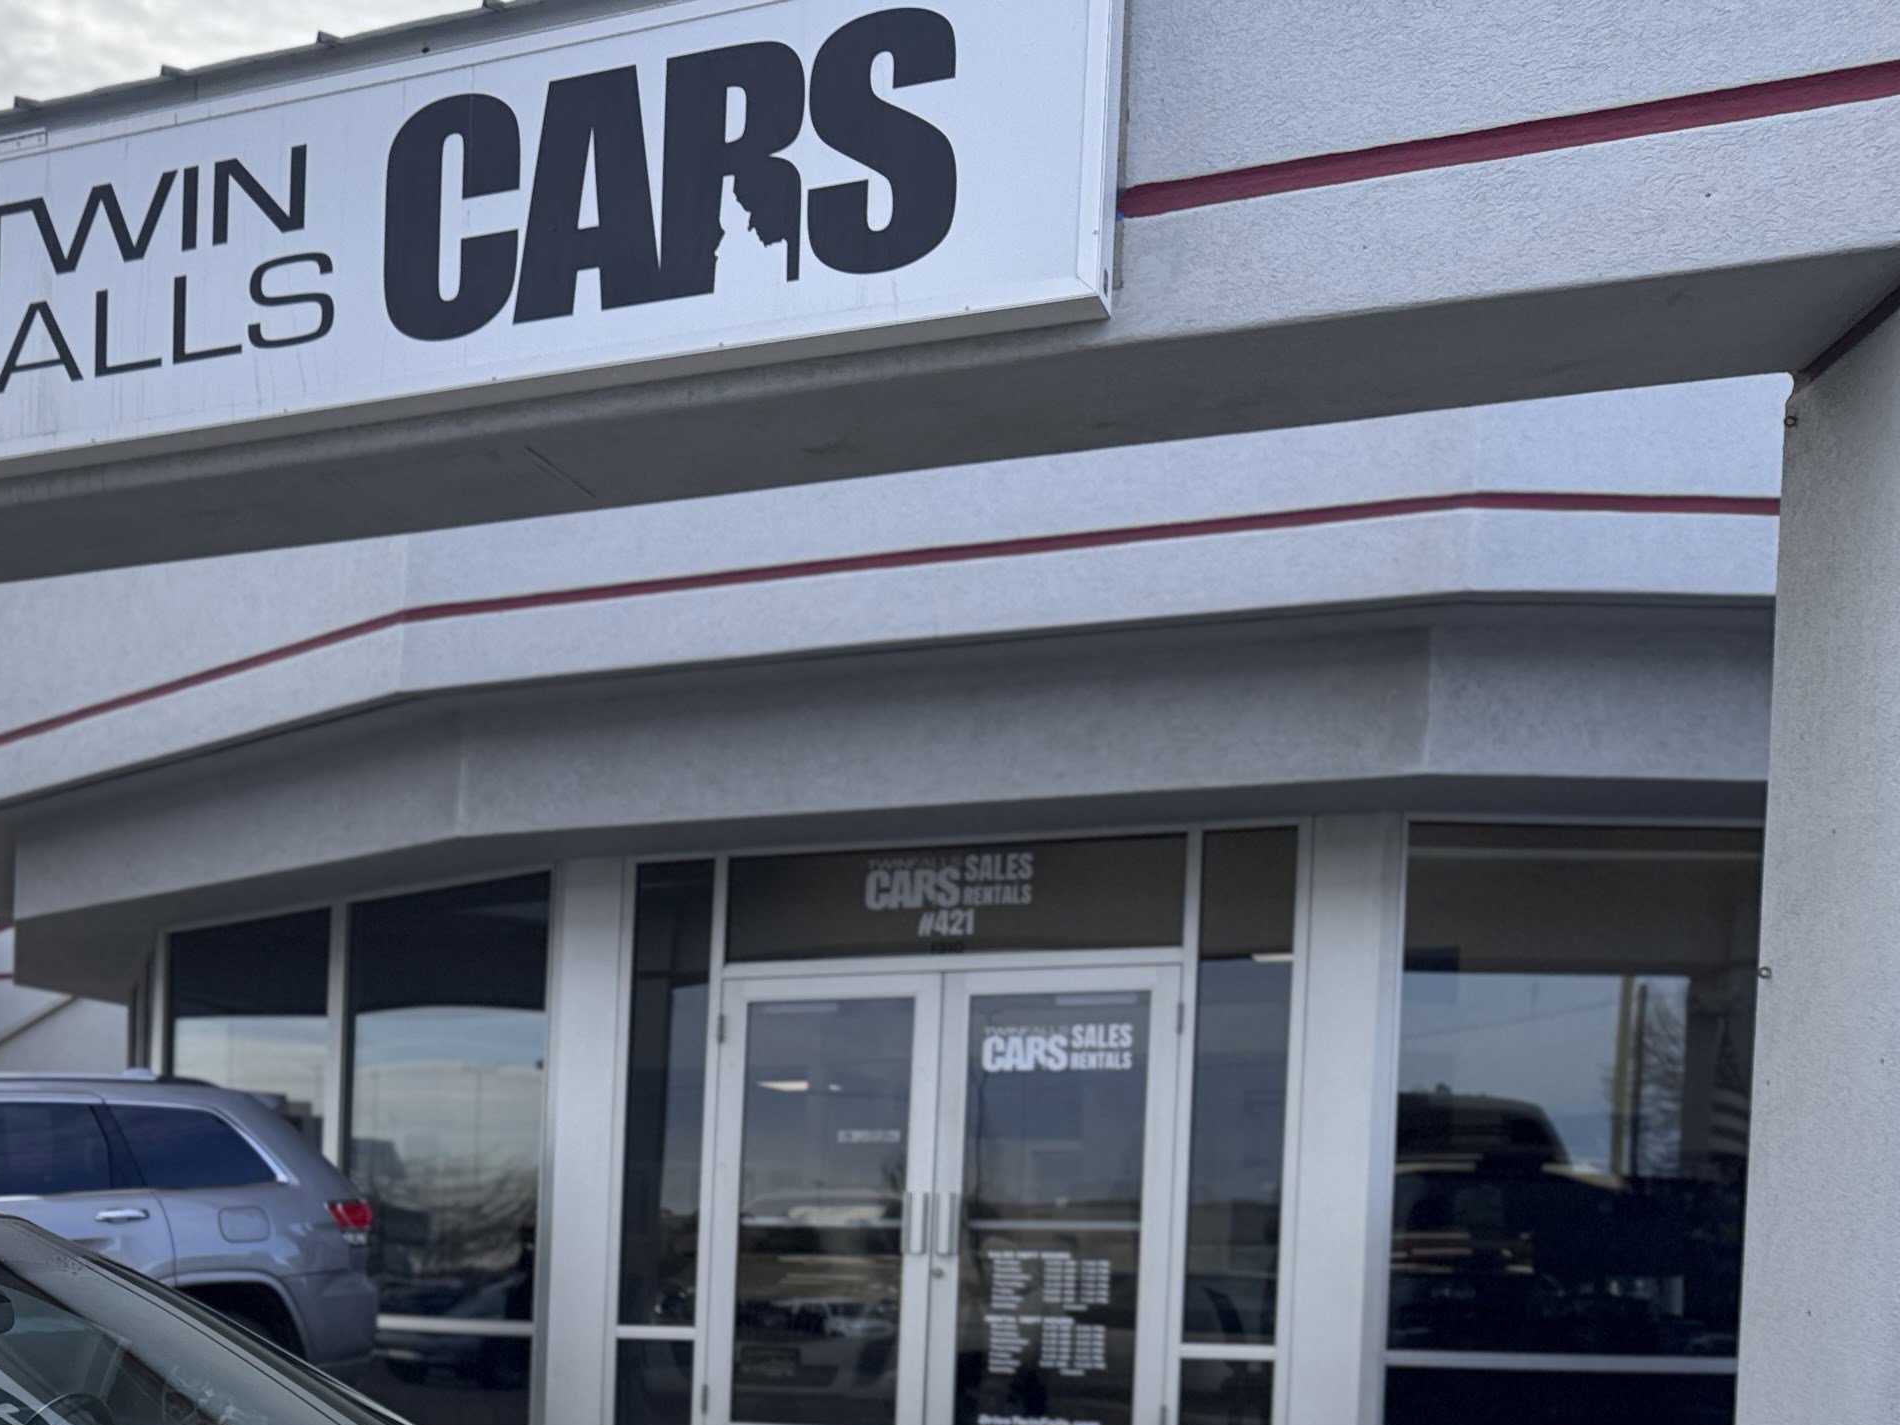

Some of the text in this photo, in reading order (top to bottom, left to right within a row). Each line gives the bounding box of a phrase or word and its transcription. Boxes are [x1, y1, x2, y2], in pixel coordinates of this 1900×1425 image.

[383, 8, 957, 341] CARS
[964, 852, 1033, 881] SALES
[865, 866, 961, 911] CARS
[963, 884, 1032, 906] RENTALS
[917, 909, 975, 937] #421
[1071, 1023, 1133, 1048] SALES
[982, 1034, 1068, 1072] CARS
[1069, 1050, 1132, 1070] RENTALS
